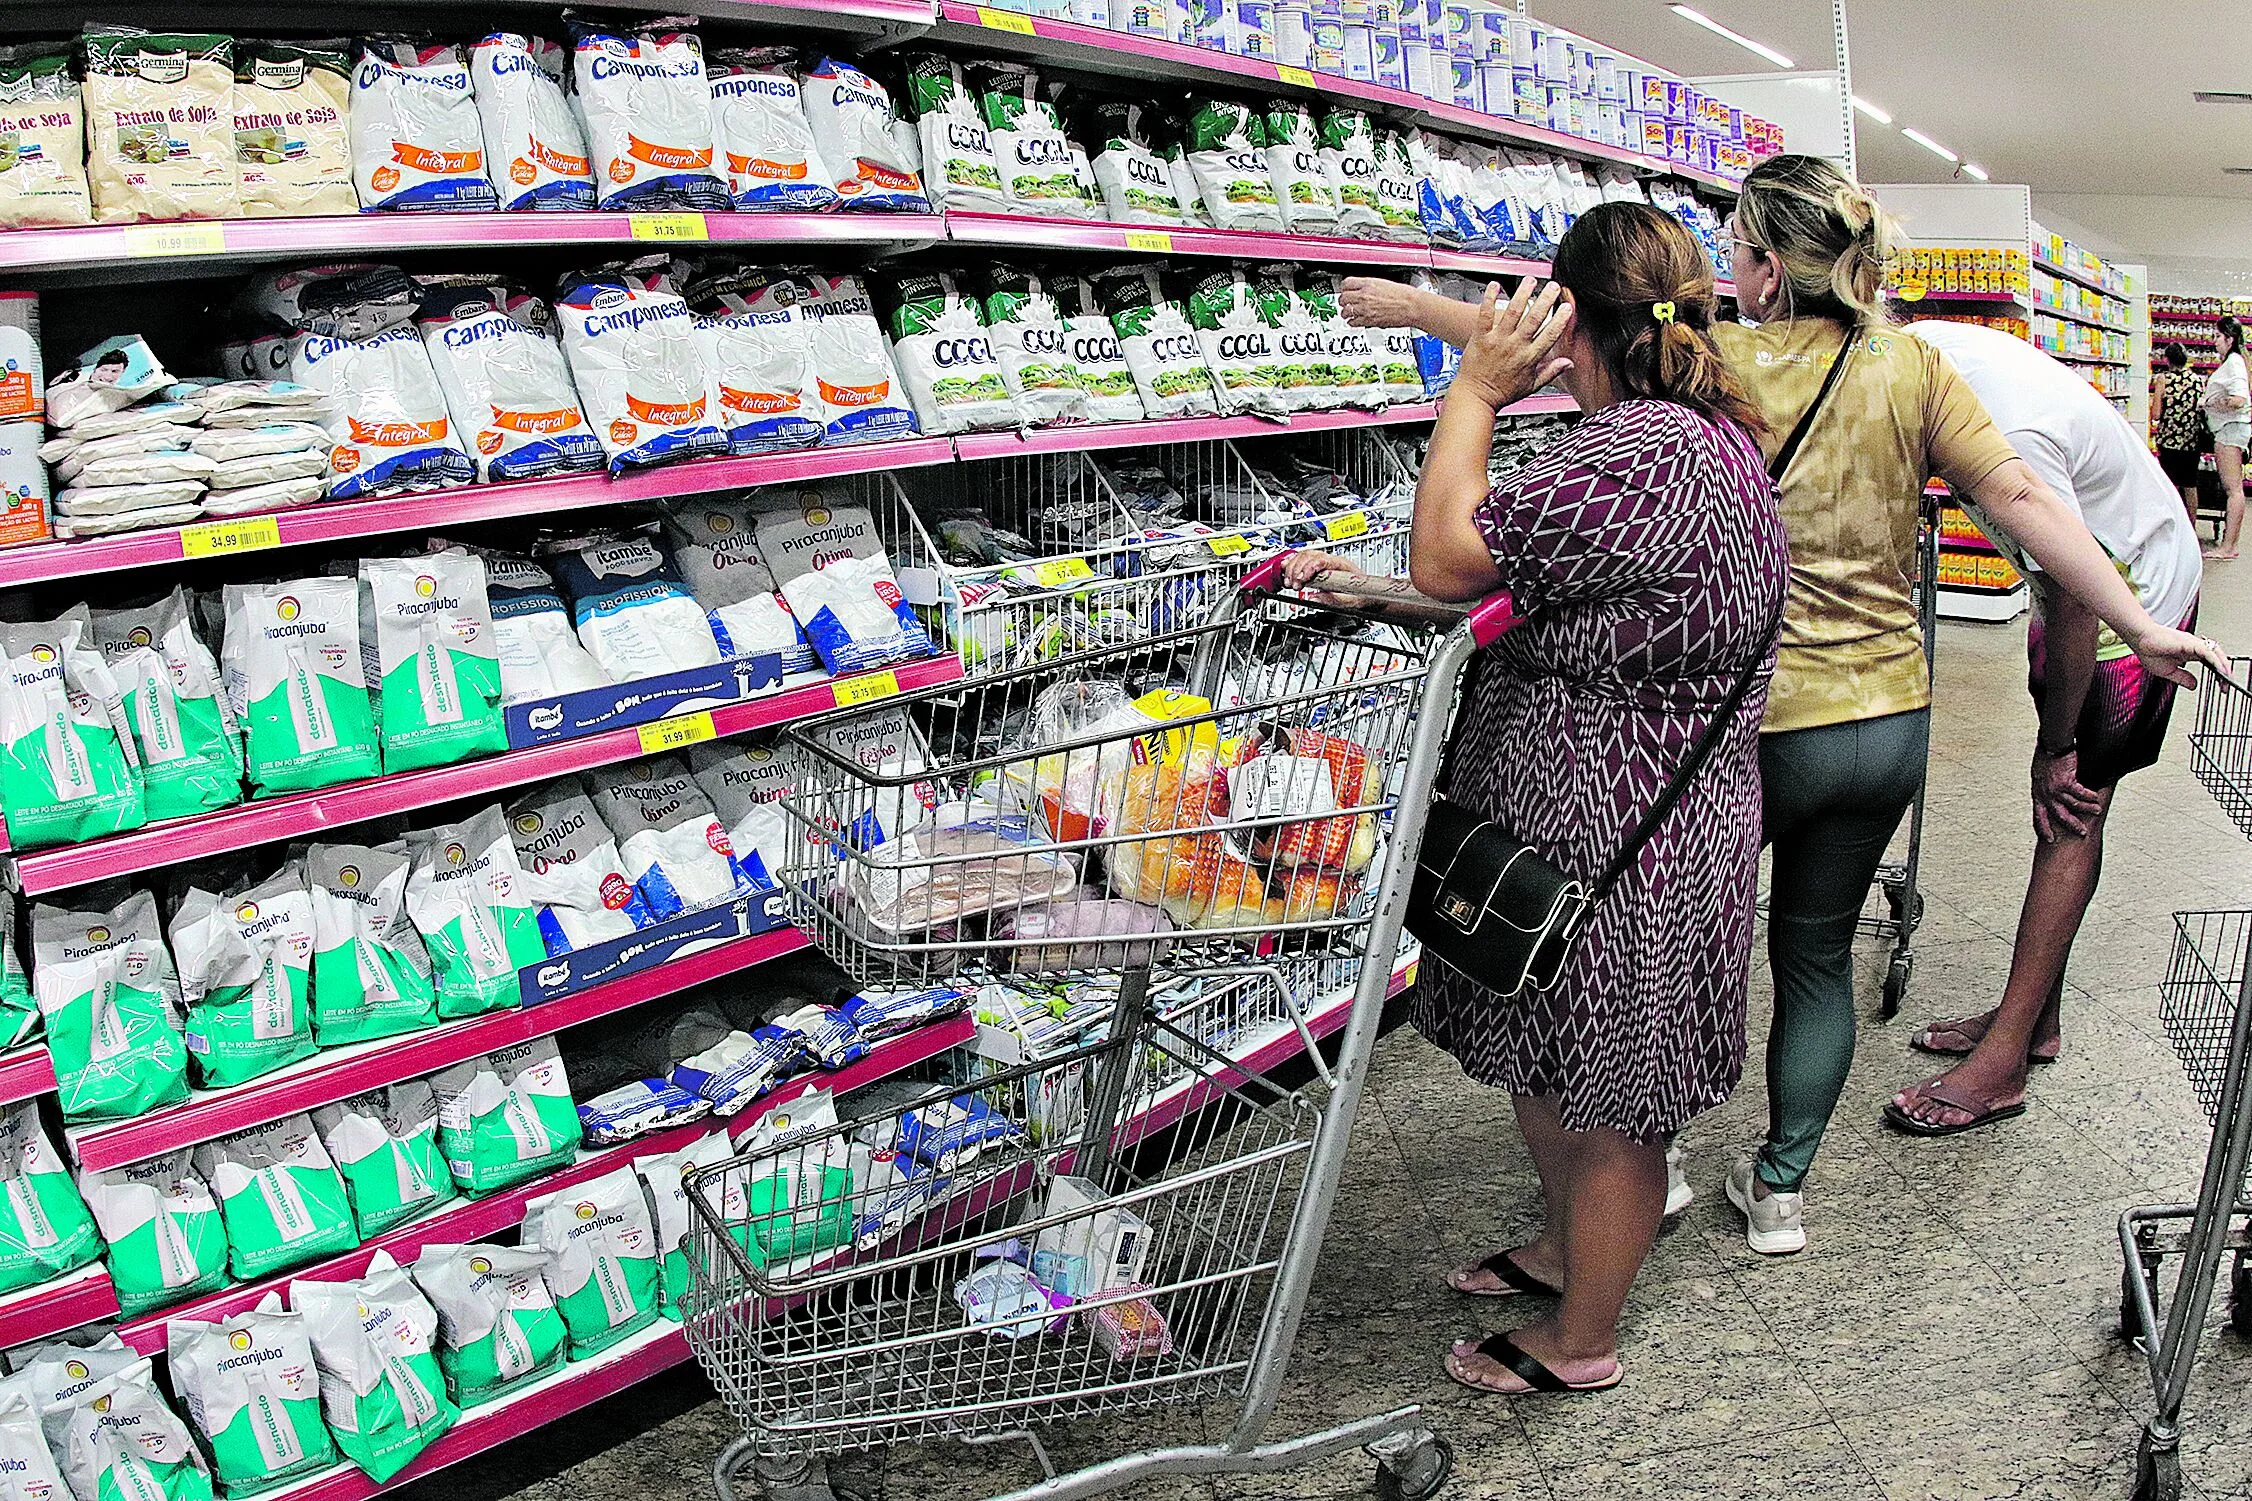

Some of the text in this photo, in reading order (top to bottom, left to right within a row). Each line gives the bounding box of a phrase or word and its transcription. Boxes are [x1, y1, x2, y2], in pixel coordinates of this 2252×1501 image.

[141, 57, 185, 68] Germina
[257, 65, 302, 76] Germina
[707, 67, 729, 78] mbaré
[19, 111, 71, 128] de Soja
[115, 105, 217, 127] Extrato de Soja
[235, 106, 336, 131] Extrato de Soja
[650, 148, 696, 165] Integral
[1017, 139, 1072, 165] CCGL
[416, 154, 466, 172] Integral
[750, 163, 791, 178] Integral
[1127, 157, 1167, 186] CCGL
[655, 226, 676, 235] 31.75
[156, 238, 181, 249] 10.99
[453, 302, 490, 318] Embaré
[801, 298, 868, 320] mponesa
[1075, 337, 1124, 362] CCGL
[1219, 334, 1271, 359] CCGL
[1281, 332, 1325, 355] CCGL
[740, 395, 789, 409] Integral
[834, 388, 876, 402] Integral
[515, 415, 566, 434] Integral
[648, 407, 691, 425] Integral
[212, 535, 237, 548] 34.99
[781, 524, 864, 553] Piracanjuba
[594, 544, 653, 564] itambé
[812, 548, 853, 571] Ótimo
[606, 560, 626, 571] FOOD
[397, 598, 458, 615] Piracanjuba
[264, 621, 326, 639] Piracanjuba
[426, 644, 446, 713] desnatado
[148, 677, 168, 750] desnatado
[297, 668, 320, 740] desnatado
[615, 694, 641, 714] BOM
[535, 710, 559, 723] itambé
[663, 733, 683, 744] 31.99
[433, 856, 489, 883] iracanjuba
[601, 880, 623, 899] FERRO
[620, 942, 644, 963] BOM
[543, 969, 568, 982] itambé
[265, 1164, 297, 1229] desnatado
[598, 1256, 623, 1314] desnatado
[217, 1349, 282, 1375] Piracanjuba
[390, 1356, 425, 1415] desnatado
[259, 1394, 287, 1458] desnatado
[0, 1459, 26, 1474] njuba
